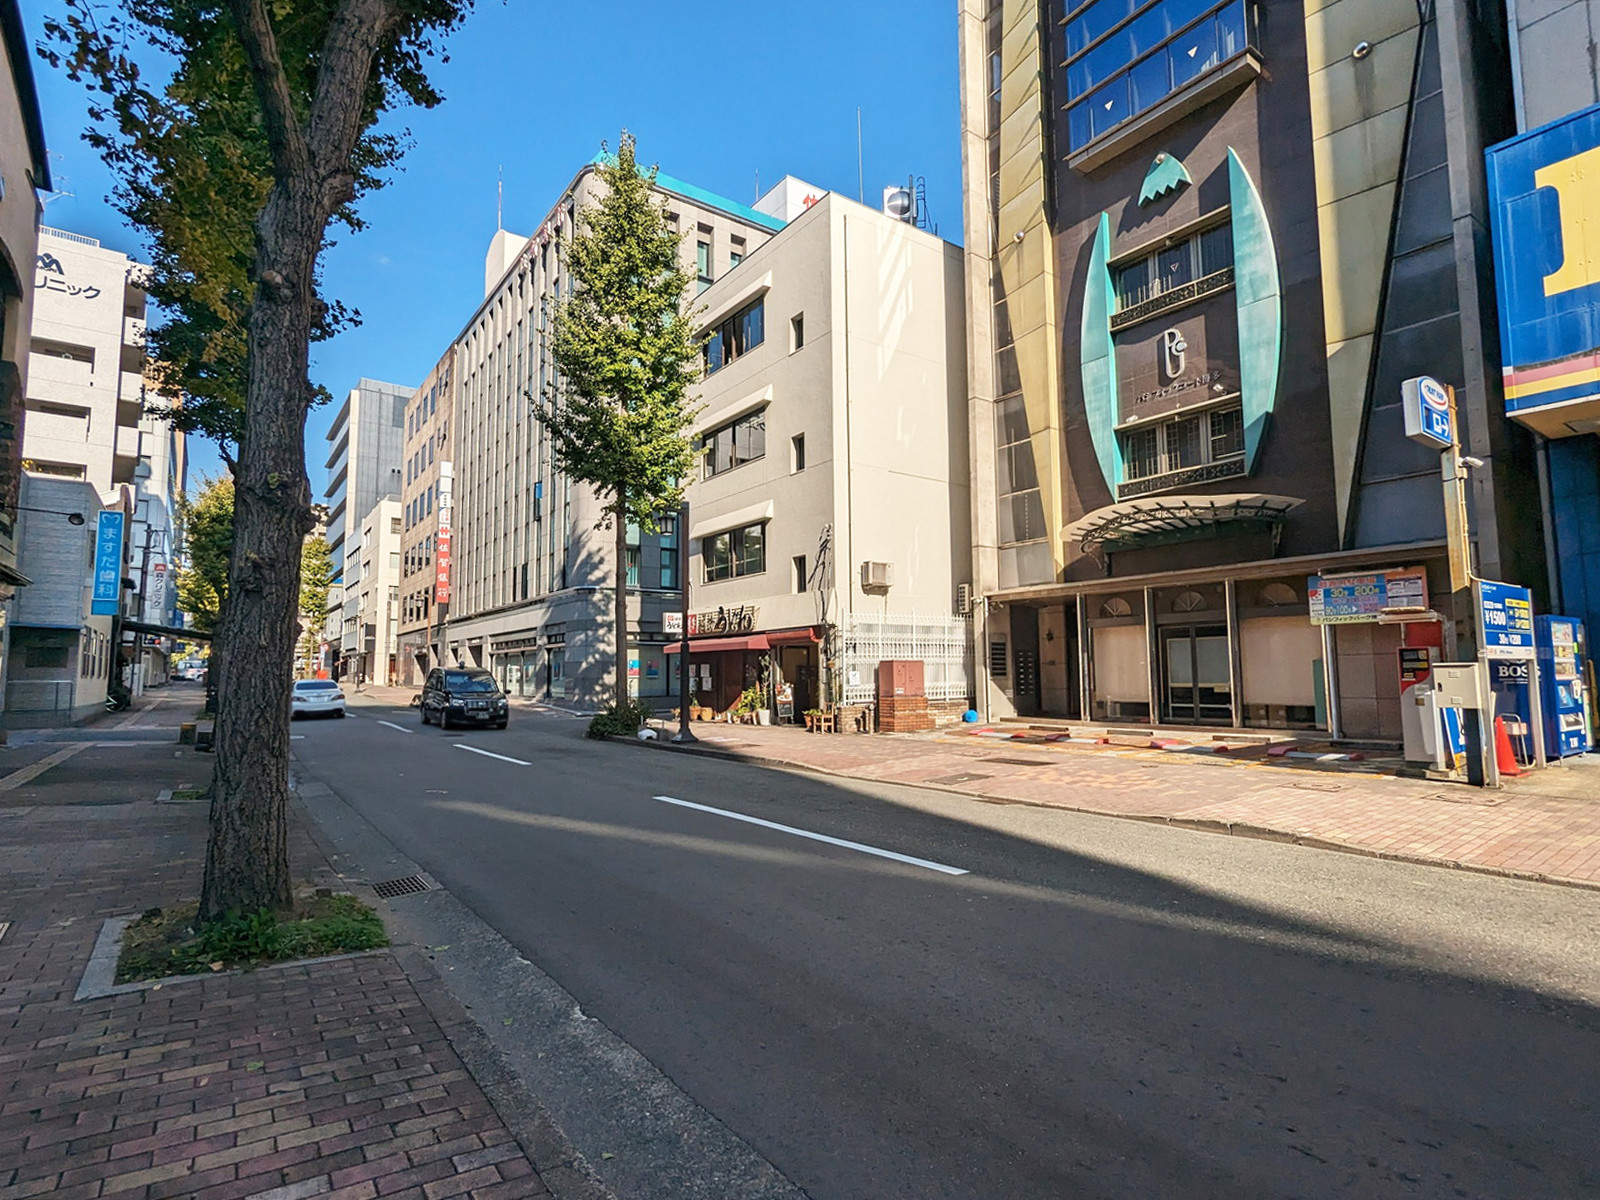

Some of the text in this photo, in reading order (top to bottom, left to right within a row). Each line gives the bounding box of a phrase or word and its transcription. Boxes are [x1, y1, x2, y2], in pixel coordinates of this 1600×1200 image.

[97, 527, 117, 597] ますだ歯科
[437, 543, 449, 597] 佐賀銀行
